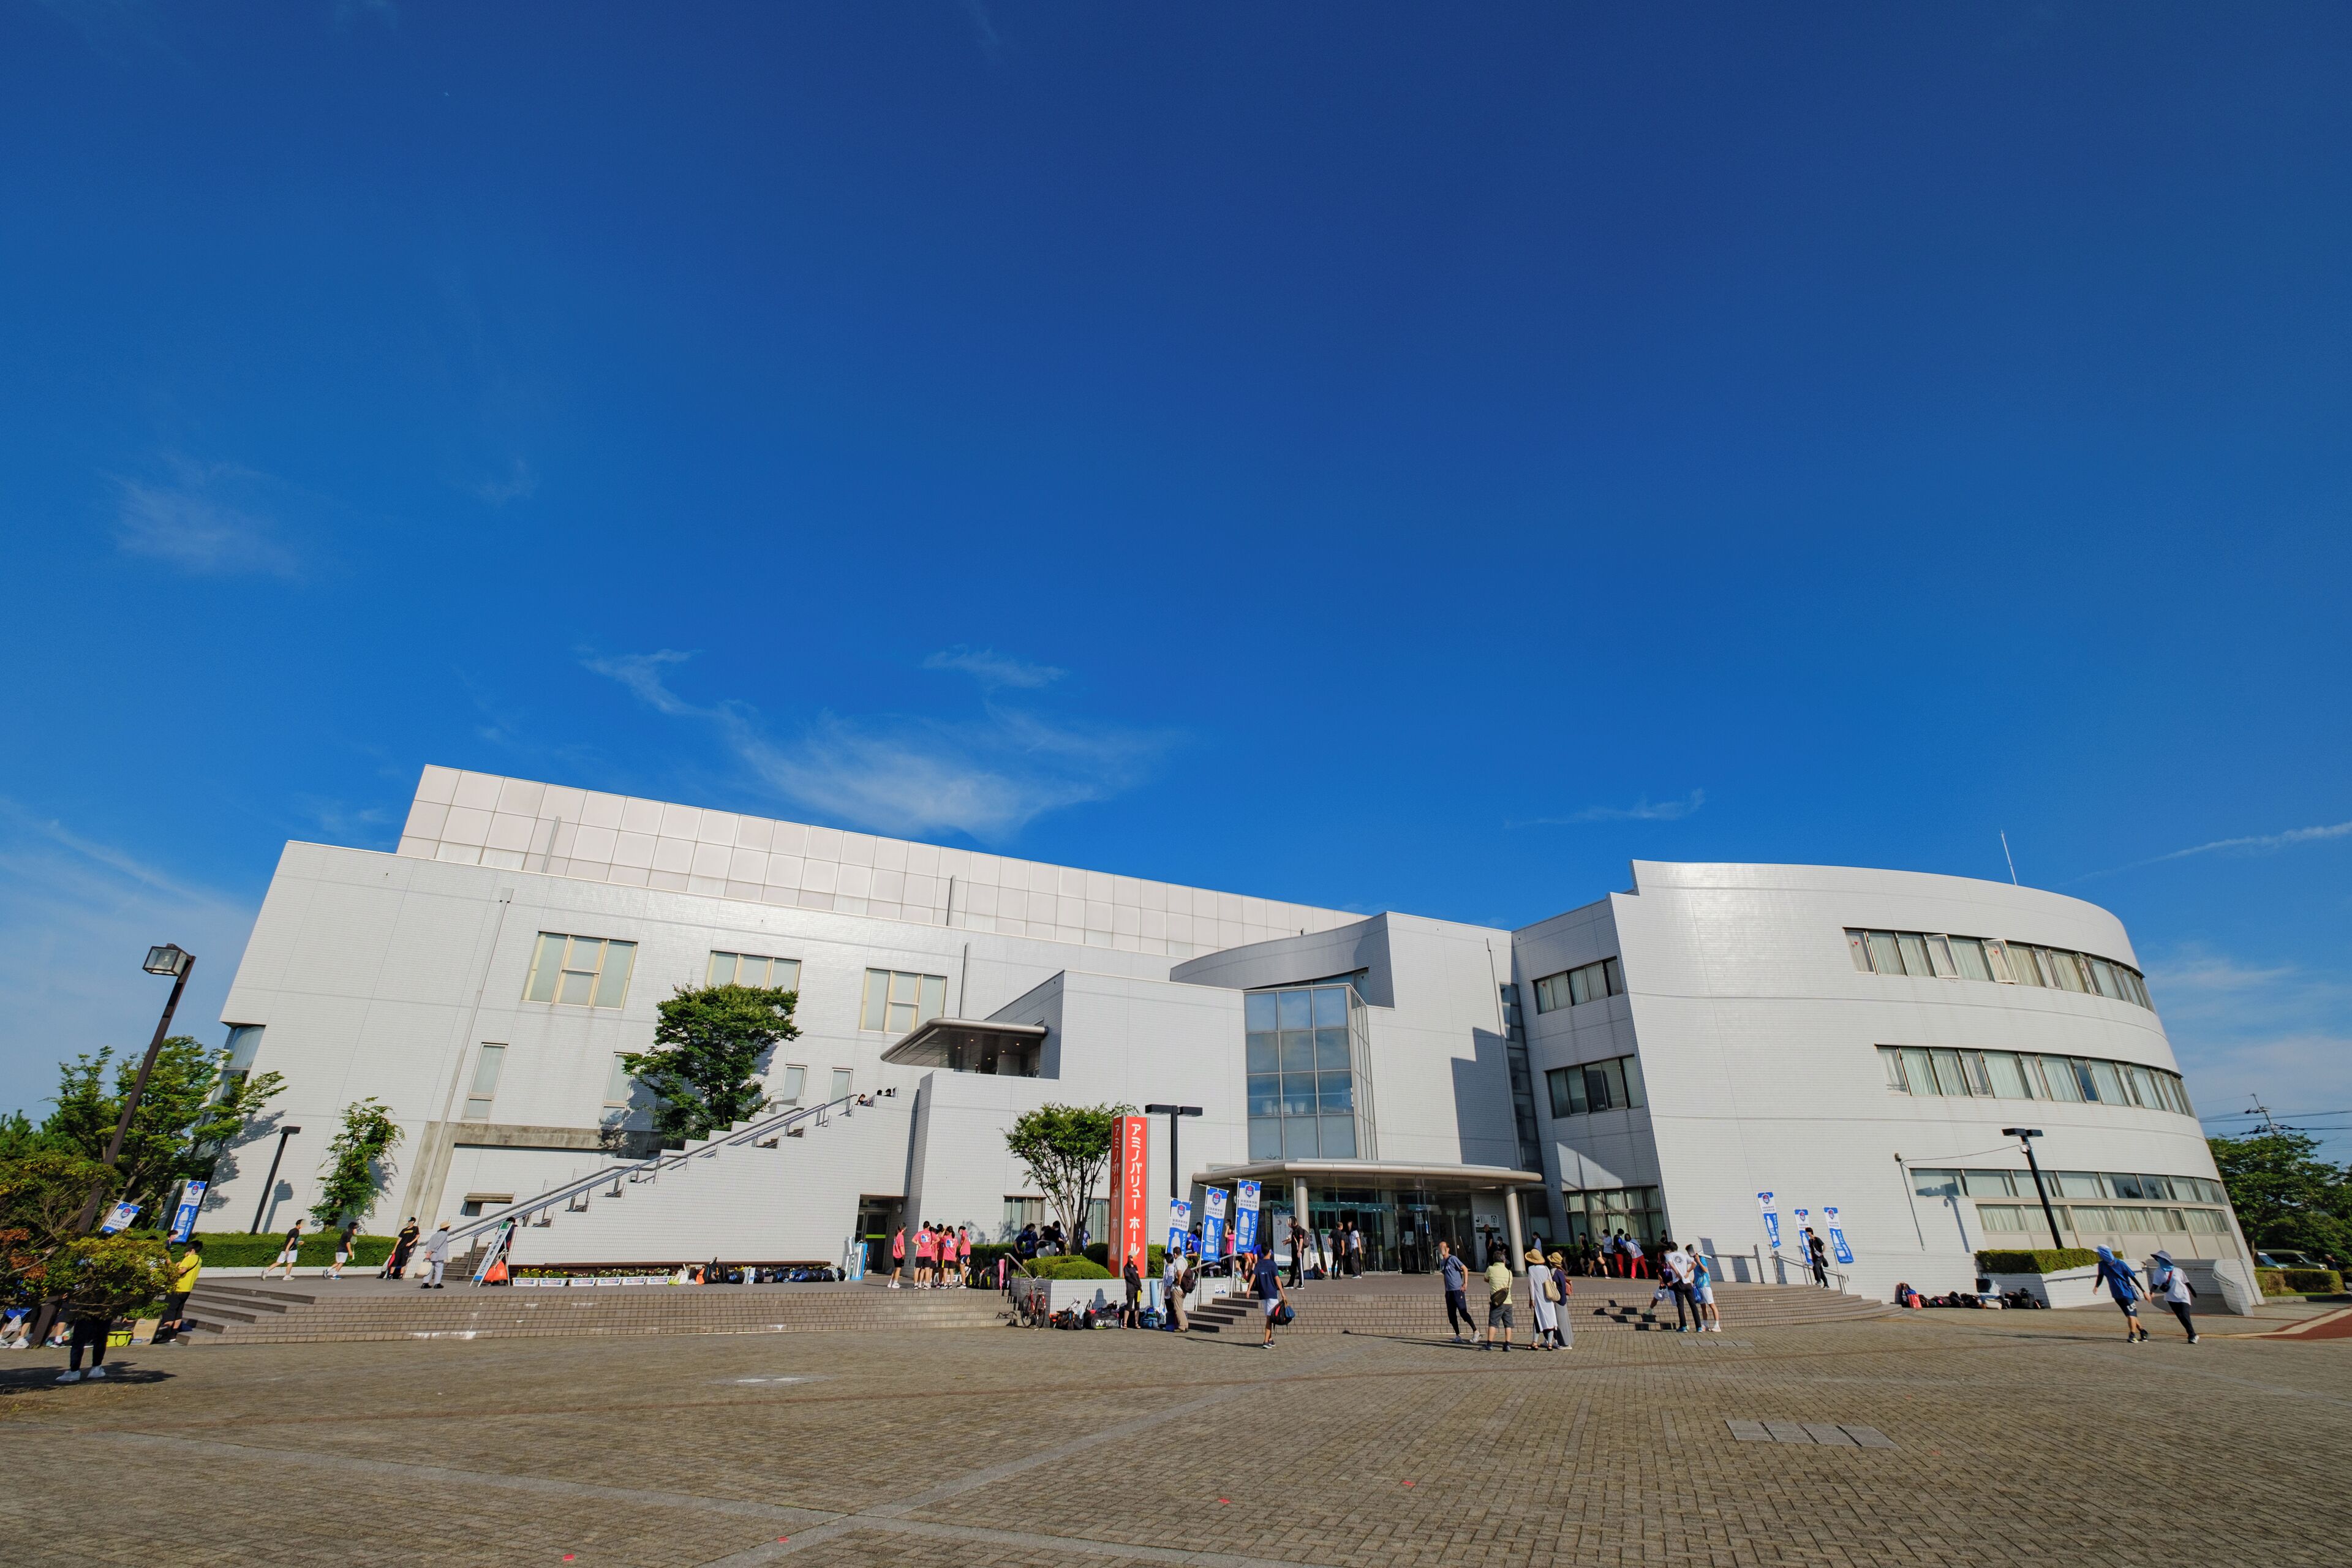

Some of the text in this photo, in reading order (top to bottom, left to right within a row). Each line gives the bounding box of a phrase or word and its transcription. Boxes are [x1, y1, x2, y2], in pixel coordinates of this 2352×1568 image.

[1112, 1125, 1120, 1210] アミノバリュー
[1129, 1123, 1142, 1256] アミノバリュー ホール
